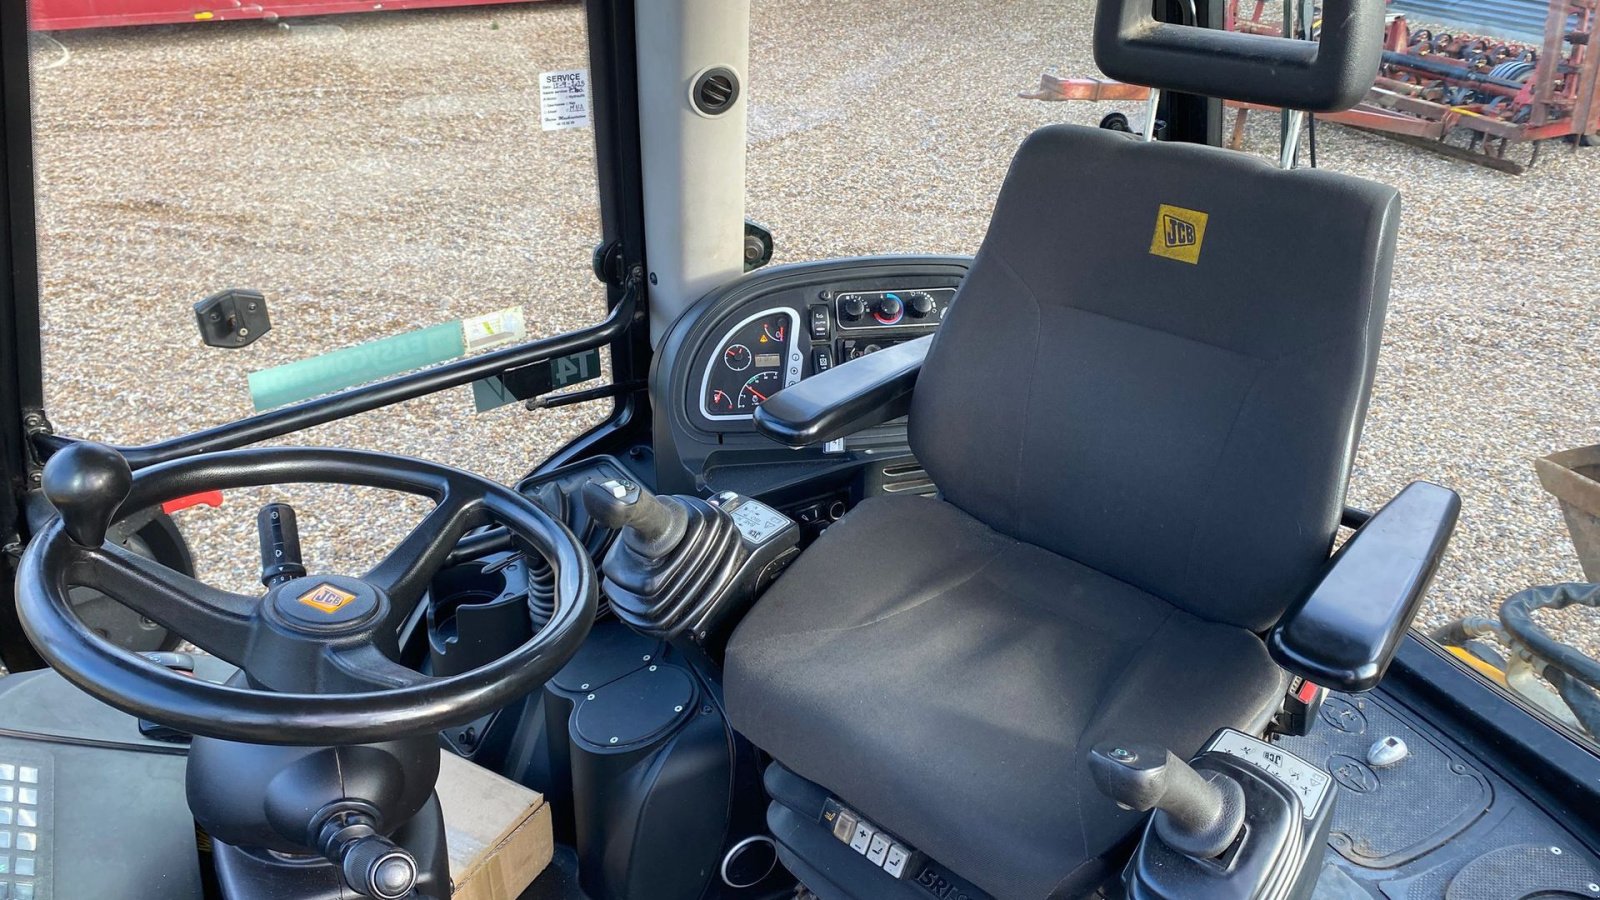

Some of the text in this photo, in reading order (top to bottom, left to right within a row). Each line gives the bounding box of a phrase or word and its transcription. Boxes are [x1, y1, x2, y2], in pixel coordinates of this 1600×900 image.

[546, 73, 580, 83] SERVICE
[1166, 217, 1194, 245] JCB
[315, 590, 341, 606] JCB
[1264, 752, 1281, 765] JCB
